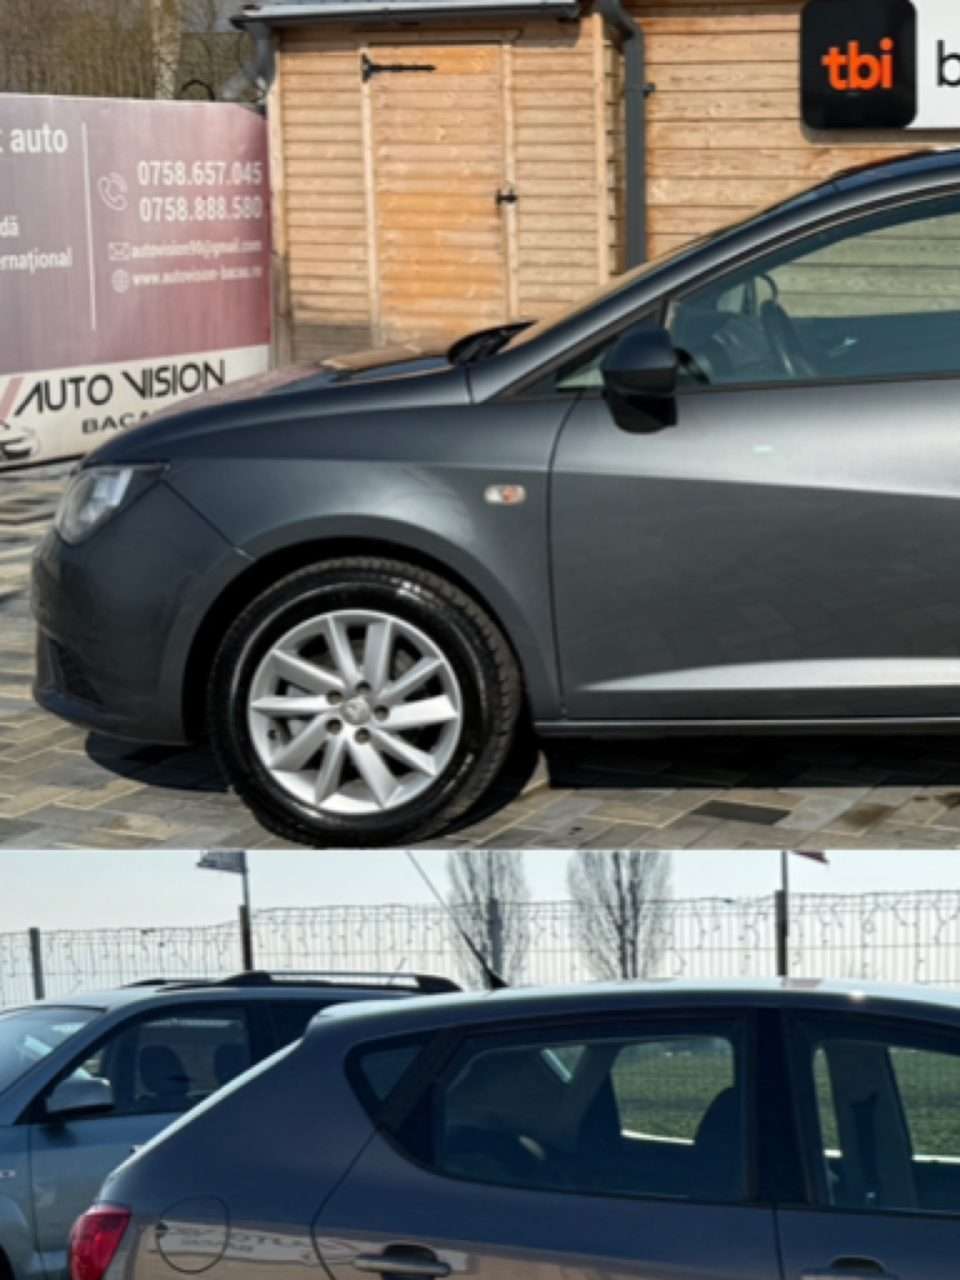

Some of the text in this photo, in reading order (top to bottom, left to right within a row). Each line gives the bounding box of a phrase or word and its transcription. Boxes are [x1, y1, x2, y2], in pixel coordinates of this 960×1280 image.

[821, 37, 893, 91] tbi
[9, 122, 69, 154] auto
[137, 160, 263, 186] 0758.657.045
[14, 359, 226, 417] AUTO VISION
[82, 411, 150, 434] BAC
